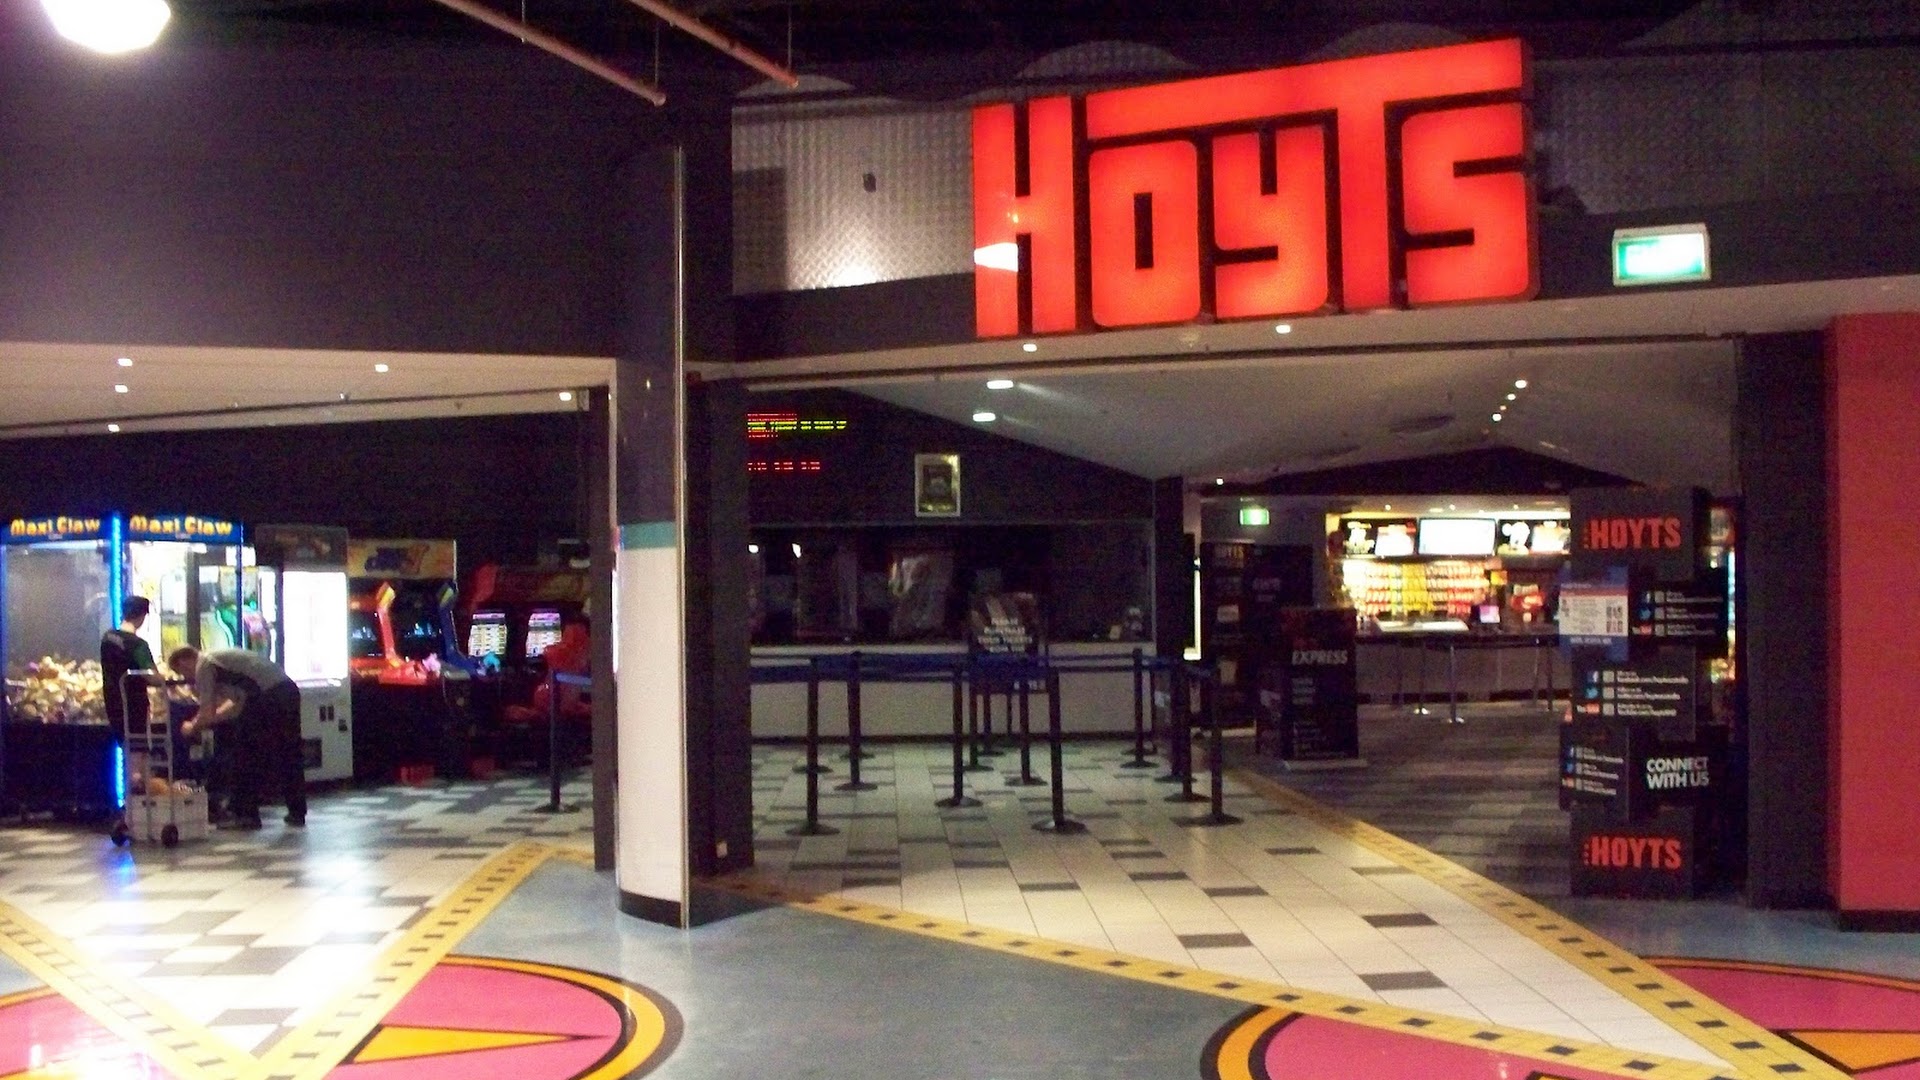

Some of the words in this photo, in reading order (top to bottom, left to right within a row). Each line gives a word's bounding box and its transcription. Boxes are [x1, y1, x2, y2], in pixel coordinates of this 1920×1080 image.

[11, 519, 53, 536] Maxi
[57, 516, 100, 534] Claw
[130, 515, 179, 534] Maxi
[185, 516, 233, 536] Claw
[1590, 517, 1682, 550] HOYTS
[1290, 649, 1348, 666] EXPRESS
[1645, 756, 1709, 773] CONNECT
[1645, 773, 1687, 790] WITH
[1689, 771, 1710, 787] US
[1590, 836, 1682, 870] HOYTS
